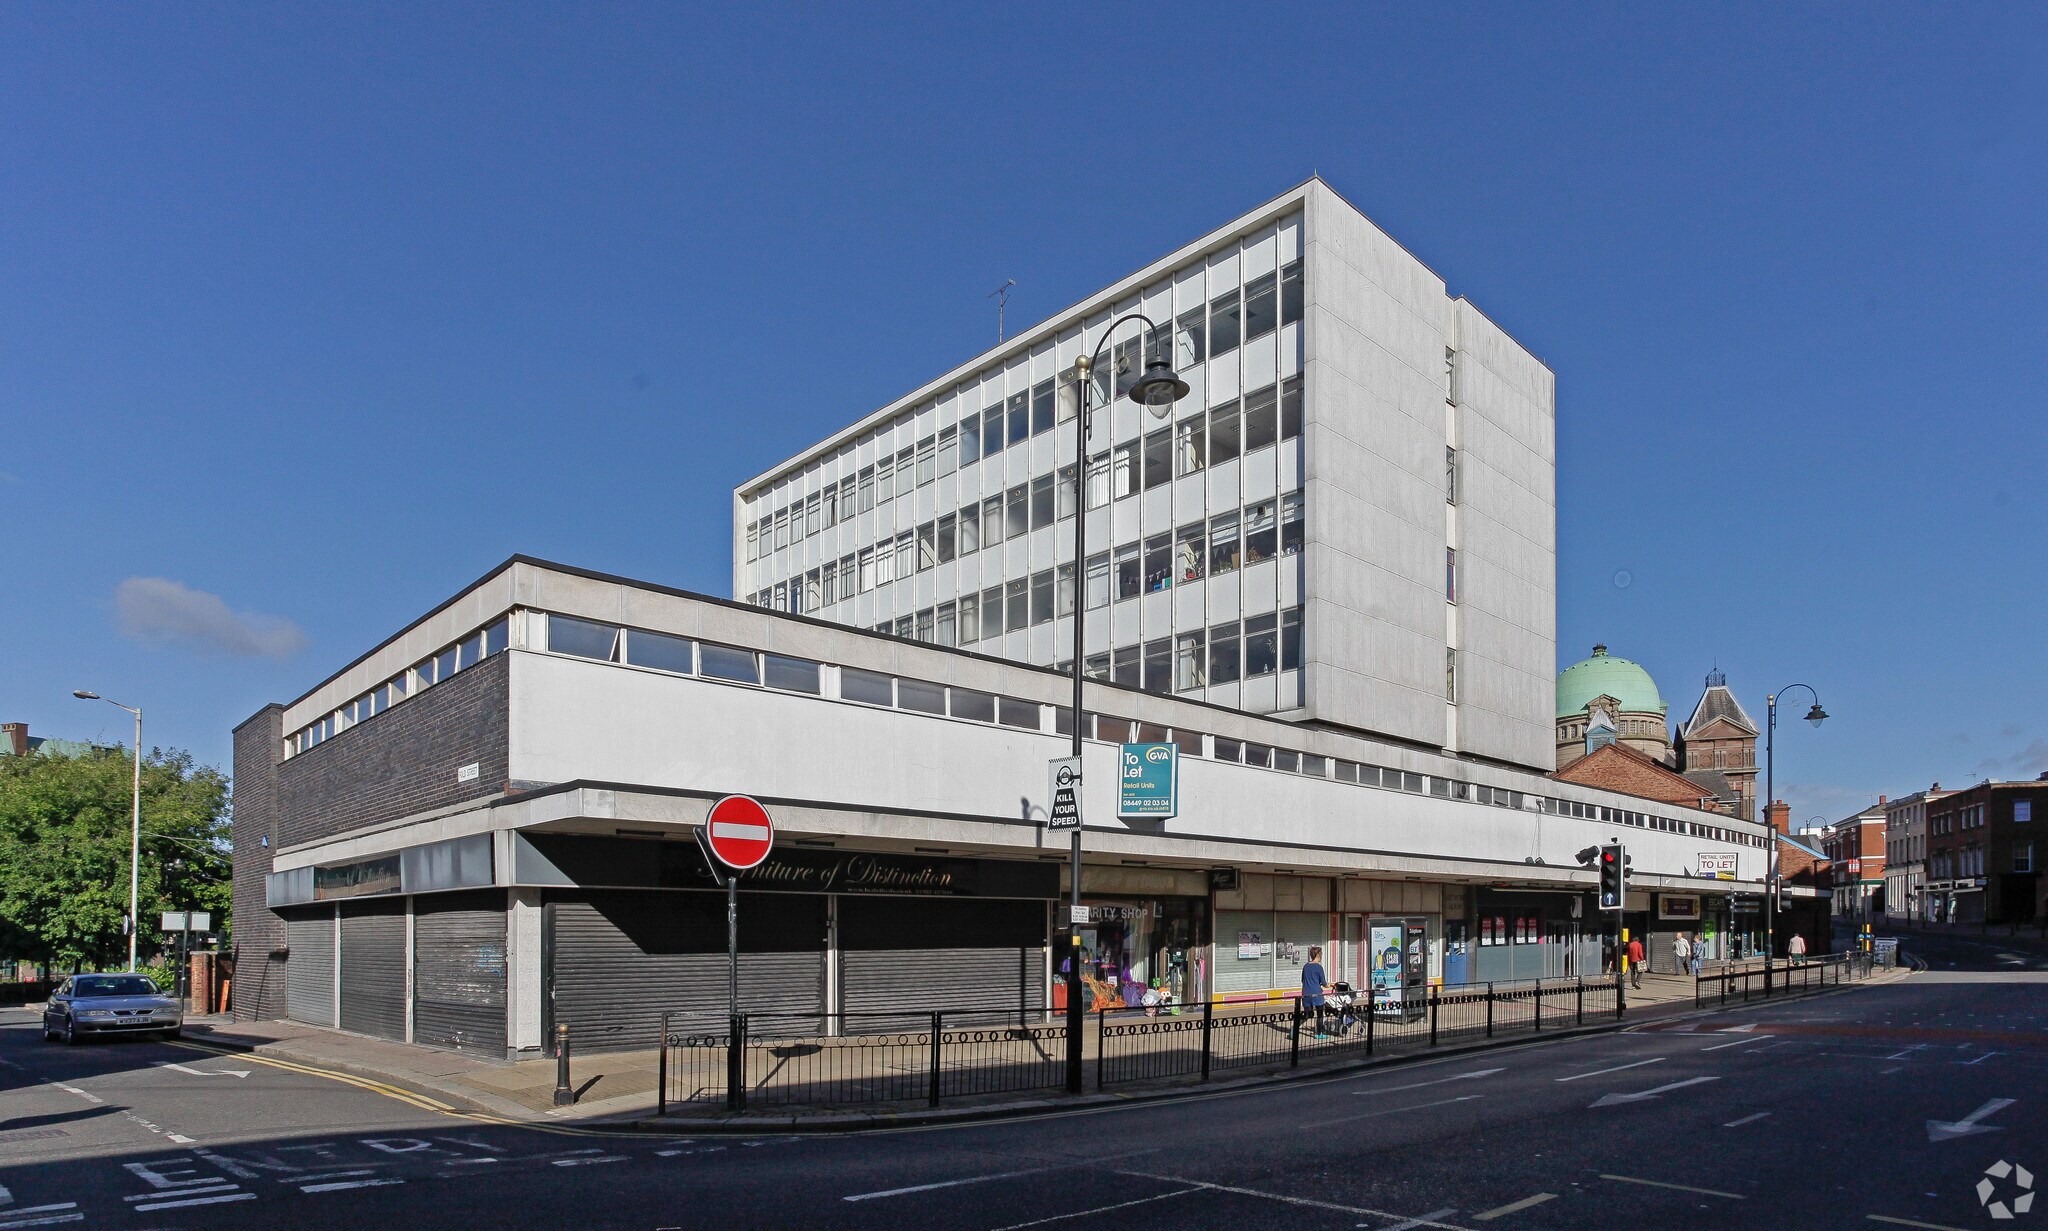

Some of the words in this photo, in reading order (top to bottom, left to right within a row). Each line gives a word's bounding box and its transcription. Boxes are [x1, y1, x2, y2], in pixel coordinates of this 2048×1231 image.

[1124, 752, 1139, 765] To
[1149, 752, 1169, 761] GVA
[1123, 766, 1144, 778] Let
[1056, 793, 1074, 803] KILL
[1054, 804, 1076, 815] YOUR
[1051, 816, 1077, 826] SPEED
[1701, 861, 1714, 869] TO
[1717, 861, 1735, 869] LET
[820, 861, 842, 890] of
[846, 854, 953, 887] Distinction
[1121, 907, 1148, 919] SHOP
